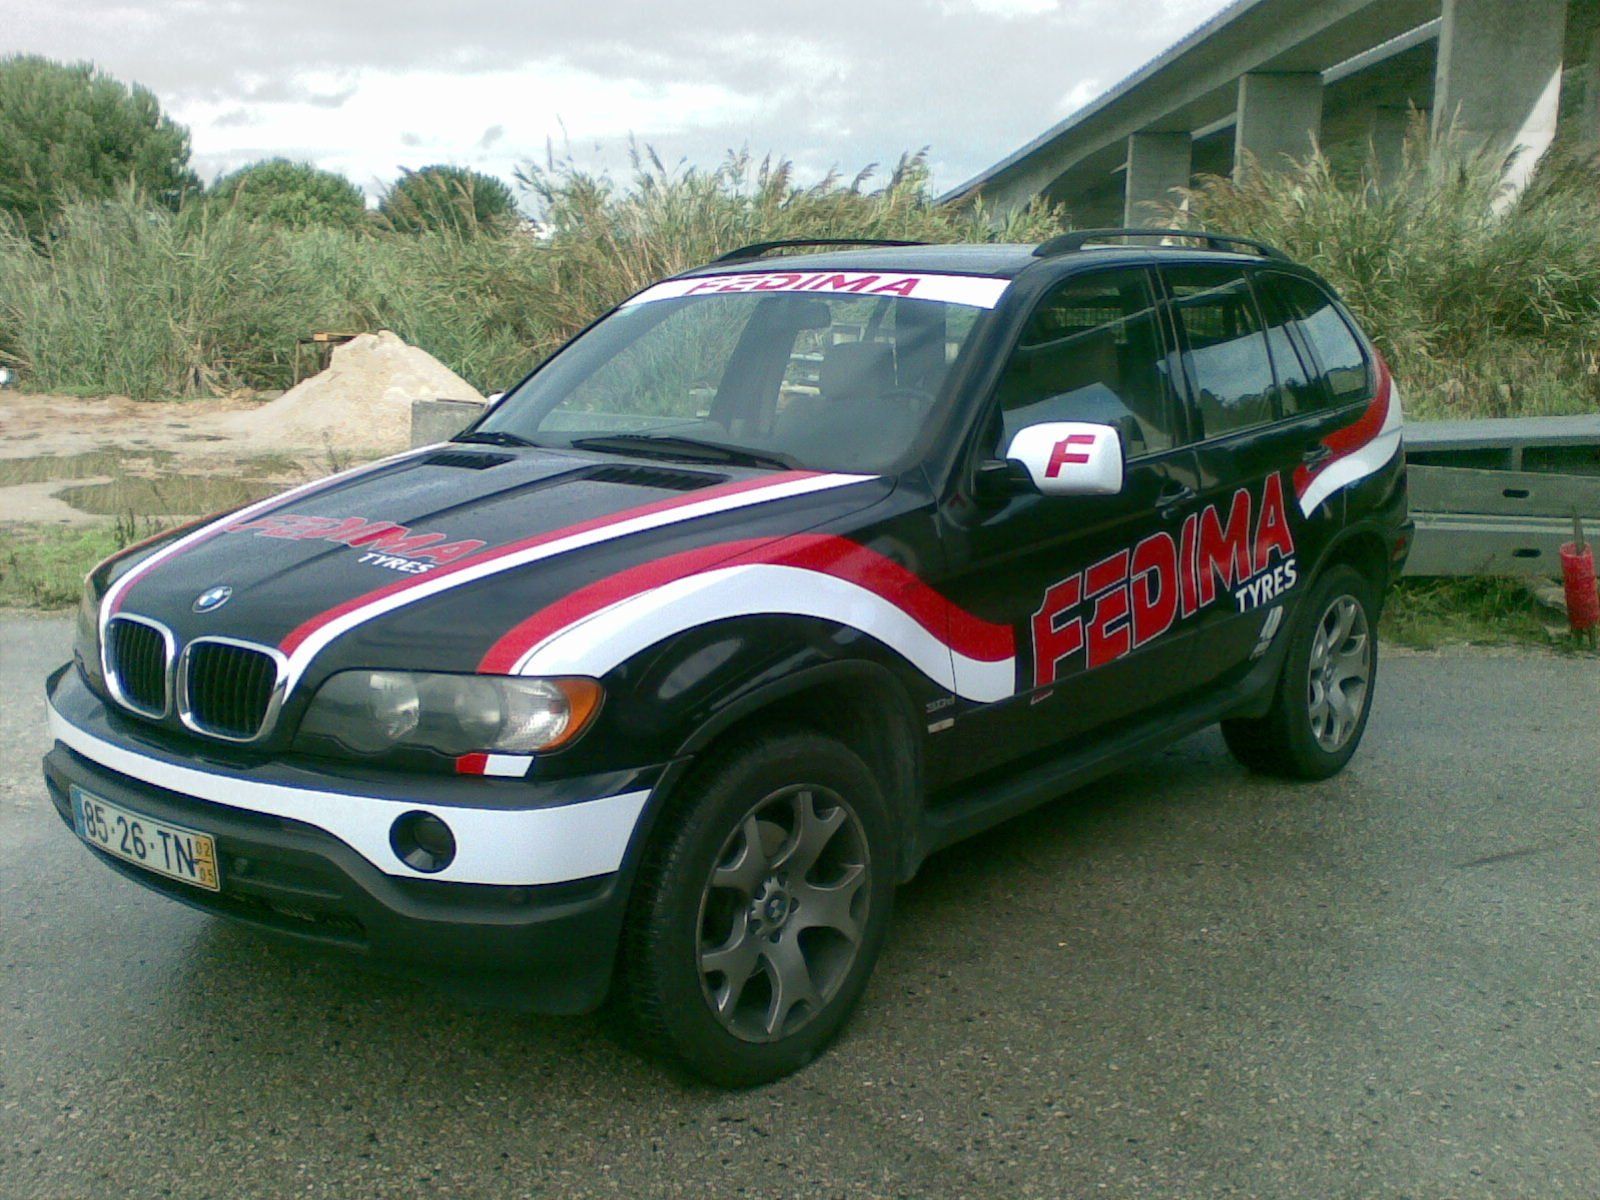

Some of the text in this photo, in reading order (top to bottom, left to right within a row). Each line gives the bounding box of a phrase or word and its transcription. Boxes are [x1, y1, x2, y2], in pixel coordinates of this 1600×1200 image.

[684, 273, 921, 296] FEDIMA
[1045, 434, 1095, 478] F
[223, 514, 487, 564] FEDIMA
[358, 552, 435, 574] TYRES
[1235, 559, 1297, 613] TYRES
[1031, 471, 1294, 704] FEDIMA
